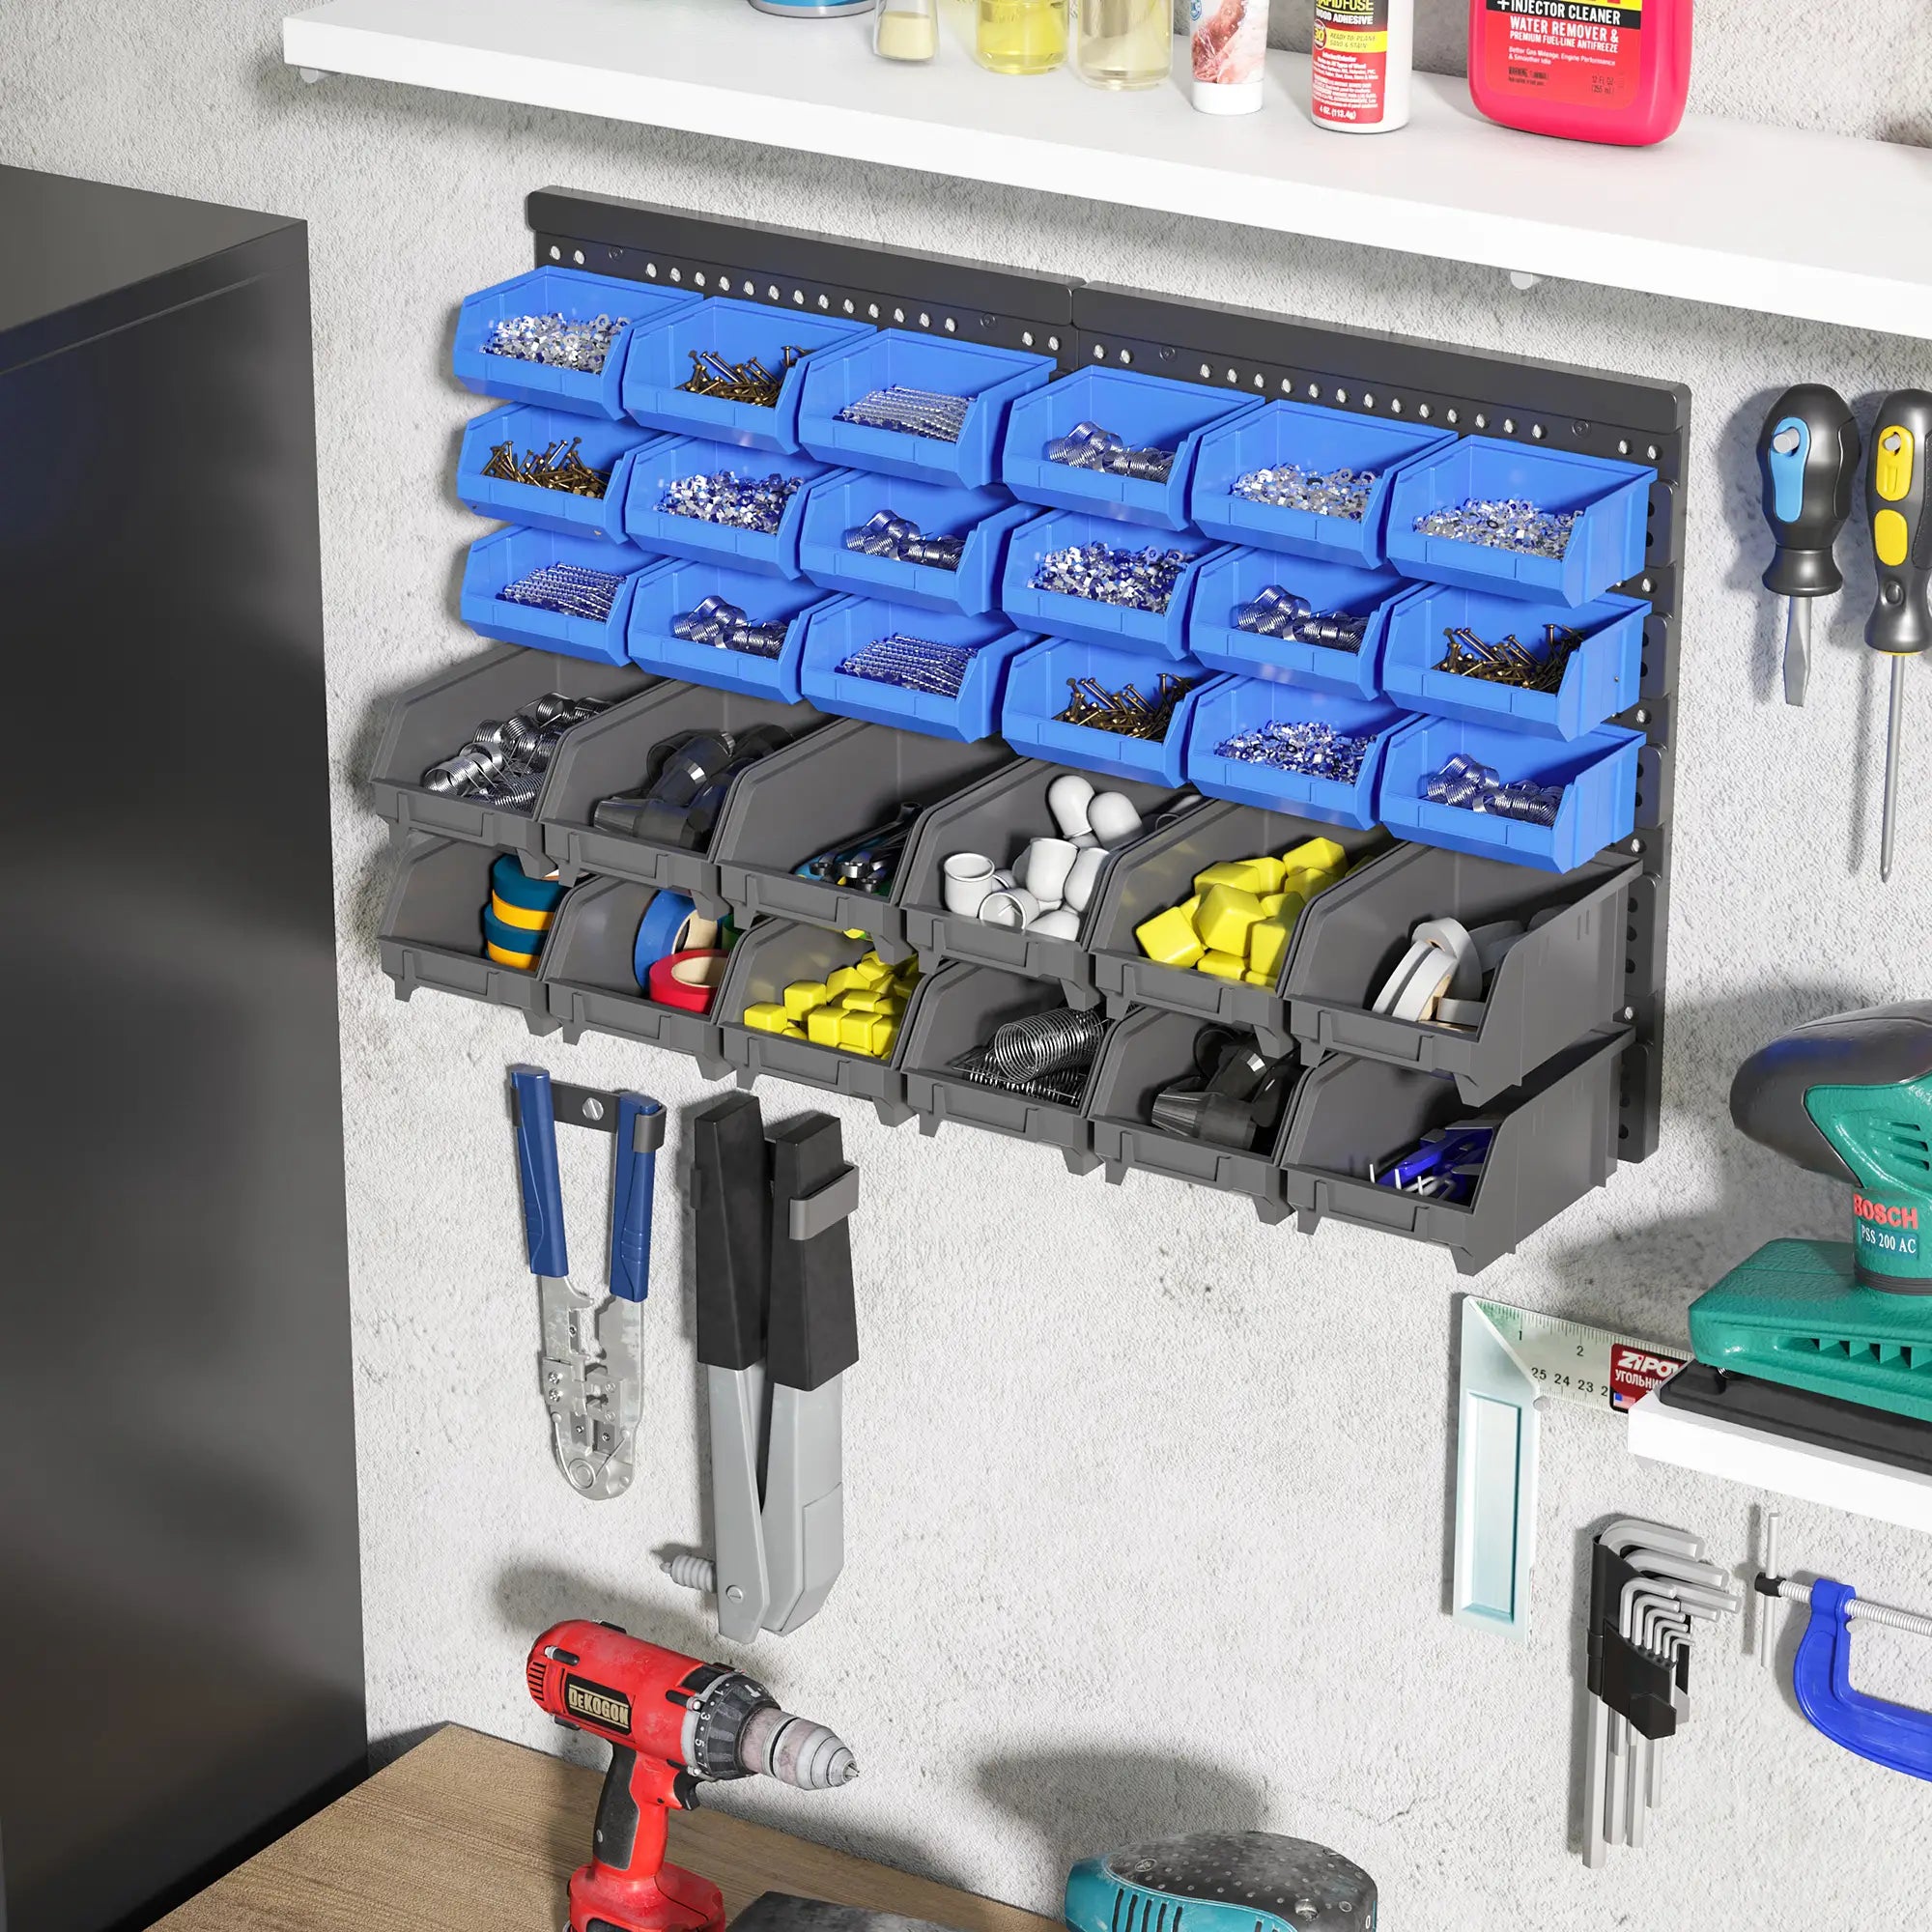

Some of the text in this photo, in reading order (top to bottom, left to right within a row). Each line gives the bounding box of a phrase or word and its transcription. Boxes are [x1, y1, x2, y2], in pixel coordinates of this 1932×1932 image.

[1333, 14, 1374, 25] ADHESIVE
[1569, 6, 1621, 25] CLEANER
[1510, 15, 1619, 43] WATER REMOVER &
[1510, 30, 1619, 54] PREMIUM FUEL-LINE ANTIFREEZE
[1580, 55, 1616, 66] Performance
[1854, 1194, 1918, 1230] BOSCH
[1861, 1224, 1917, 1254] PSS 200 AC
[1519, 1330, 1522, 1341] 1
[1577, 1345, 1584, 1357] 2
[1531, 1367, 1608, 1397] 25 24 23 2
[700, 1712, 711, 1721] 3
[696, 1739, 705, 1747] 5
